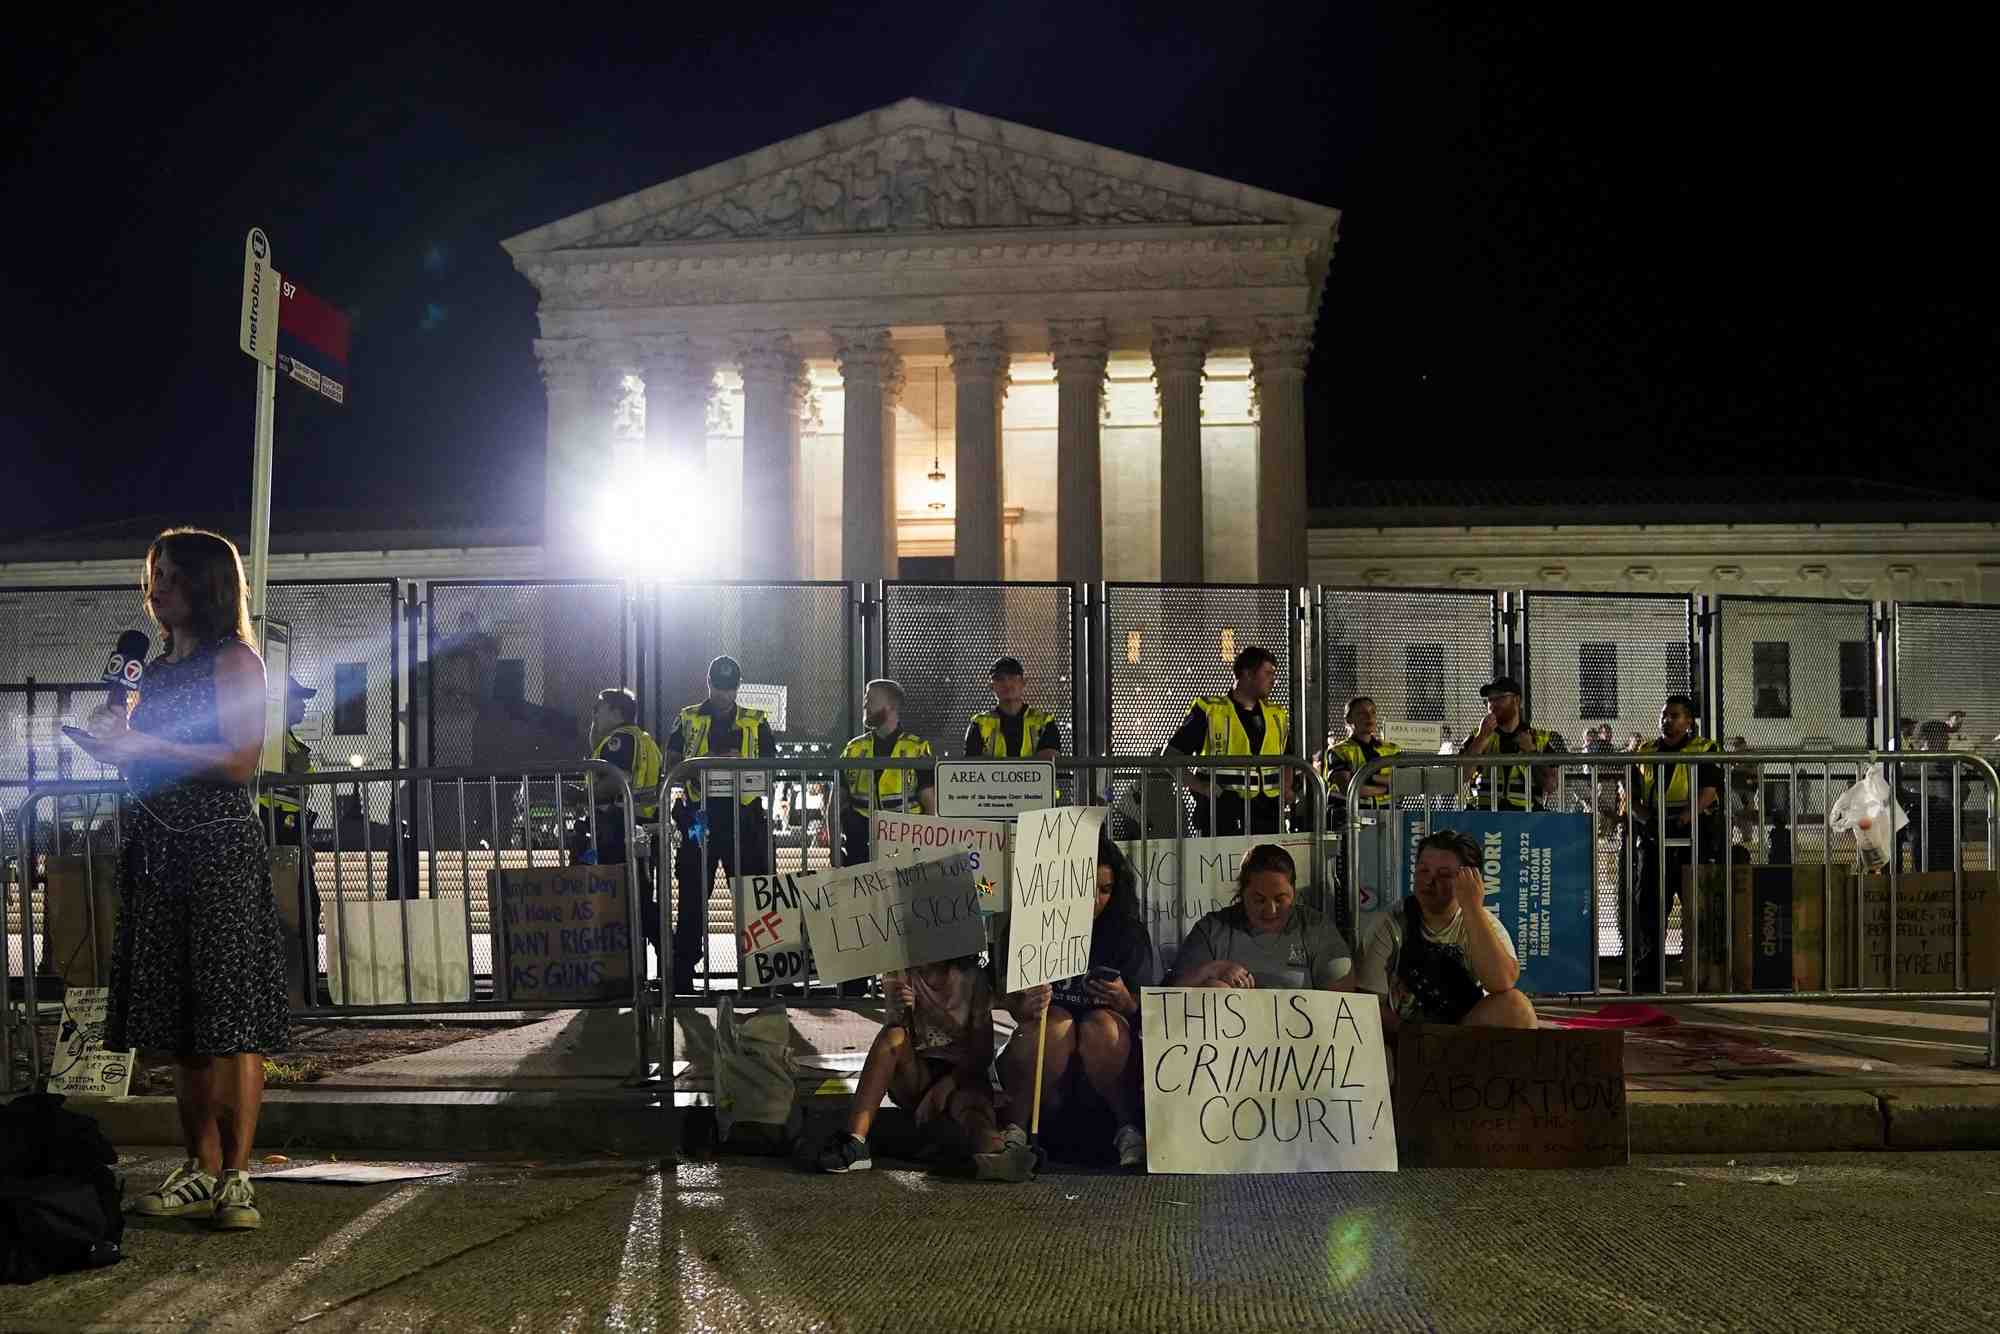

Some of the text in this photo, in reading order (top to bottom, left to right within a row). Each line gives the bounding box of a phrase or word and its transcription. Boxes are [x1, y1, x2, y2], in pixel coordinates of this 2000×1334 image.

[249, 261, 261, 352] metrobus
[282, 281, 297, 300] 97
[950, 771, 1041, 783] AREA CLOSED
[1035, 807, 1088, 857] MY
[1520, 832, 1530, 862] 2022
[588, 872, 617, 899] Day
[1016, 856, 1097, 908] VAGINA
[1199, 852, 1241, 884] ME
[1484, 831, 1502, 896] WORK
[1530, 847, 1541, 897] 10:00AM
[1541, 847, 1552, 906] BALLROOM
[803, 880, 842, 912] WE
[853, 869, 891, 899] ARE
[1519, 887, 1529, 914] JUNE
[1041, 906, 1071, 942] MY
[1518, 917, 1528, 970] THURSDAY
[1760, 900, 1778, 958] chewy
[512, 961, 607, 992] AS GUNS
[1018, 934, 1089, 988] RIGHTS
[1147, 991, 1363, 1045] THIS IS A
[1154, 1043, 1366, 1097] CRIMINAL
[1200, 1095, 1384, 1145] COURT!
